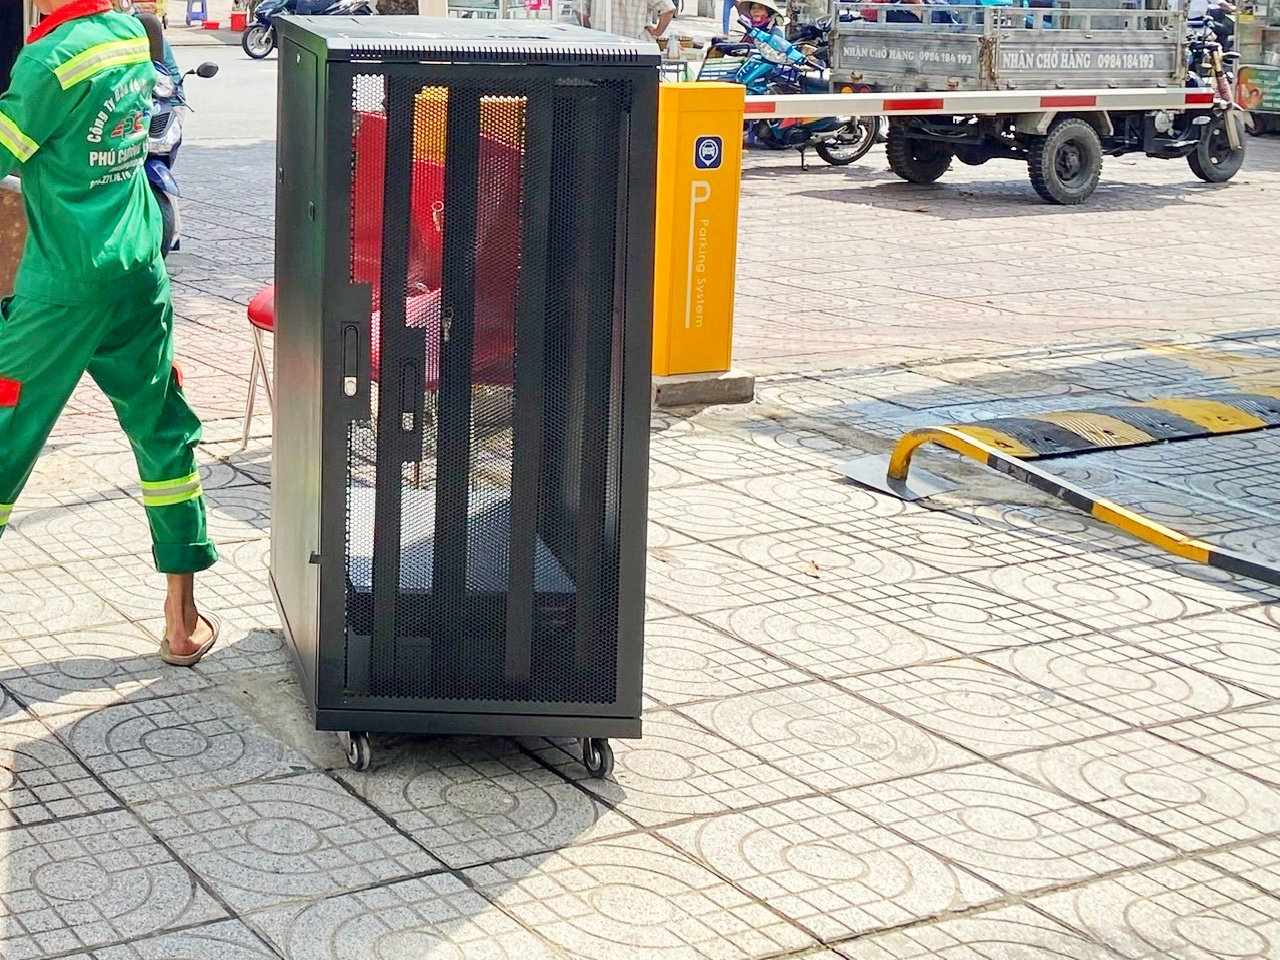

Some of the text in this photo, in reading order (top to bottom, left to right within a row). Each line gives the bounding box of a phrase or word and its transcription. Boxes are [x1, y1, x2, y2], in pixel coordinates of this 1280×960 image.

[843, 45, 868, 60] NHẬN
[869, 45, 887, 59] CHỞ
[889, 48, 915, 61] HÀNG
[1002, 49, 1034, 71] NHẬN
[1036, 47, 1059, 69] CHỞ
[1060, 48, 1091, 69] HÀNG
[89, 148, 116, 167] PHÚ
[694, 219, 709, 328] Parking System
